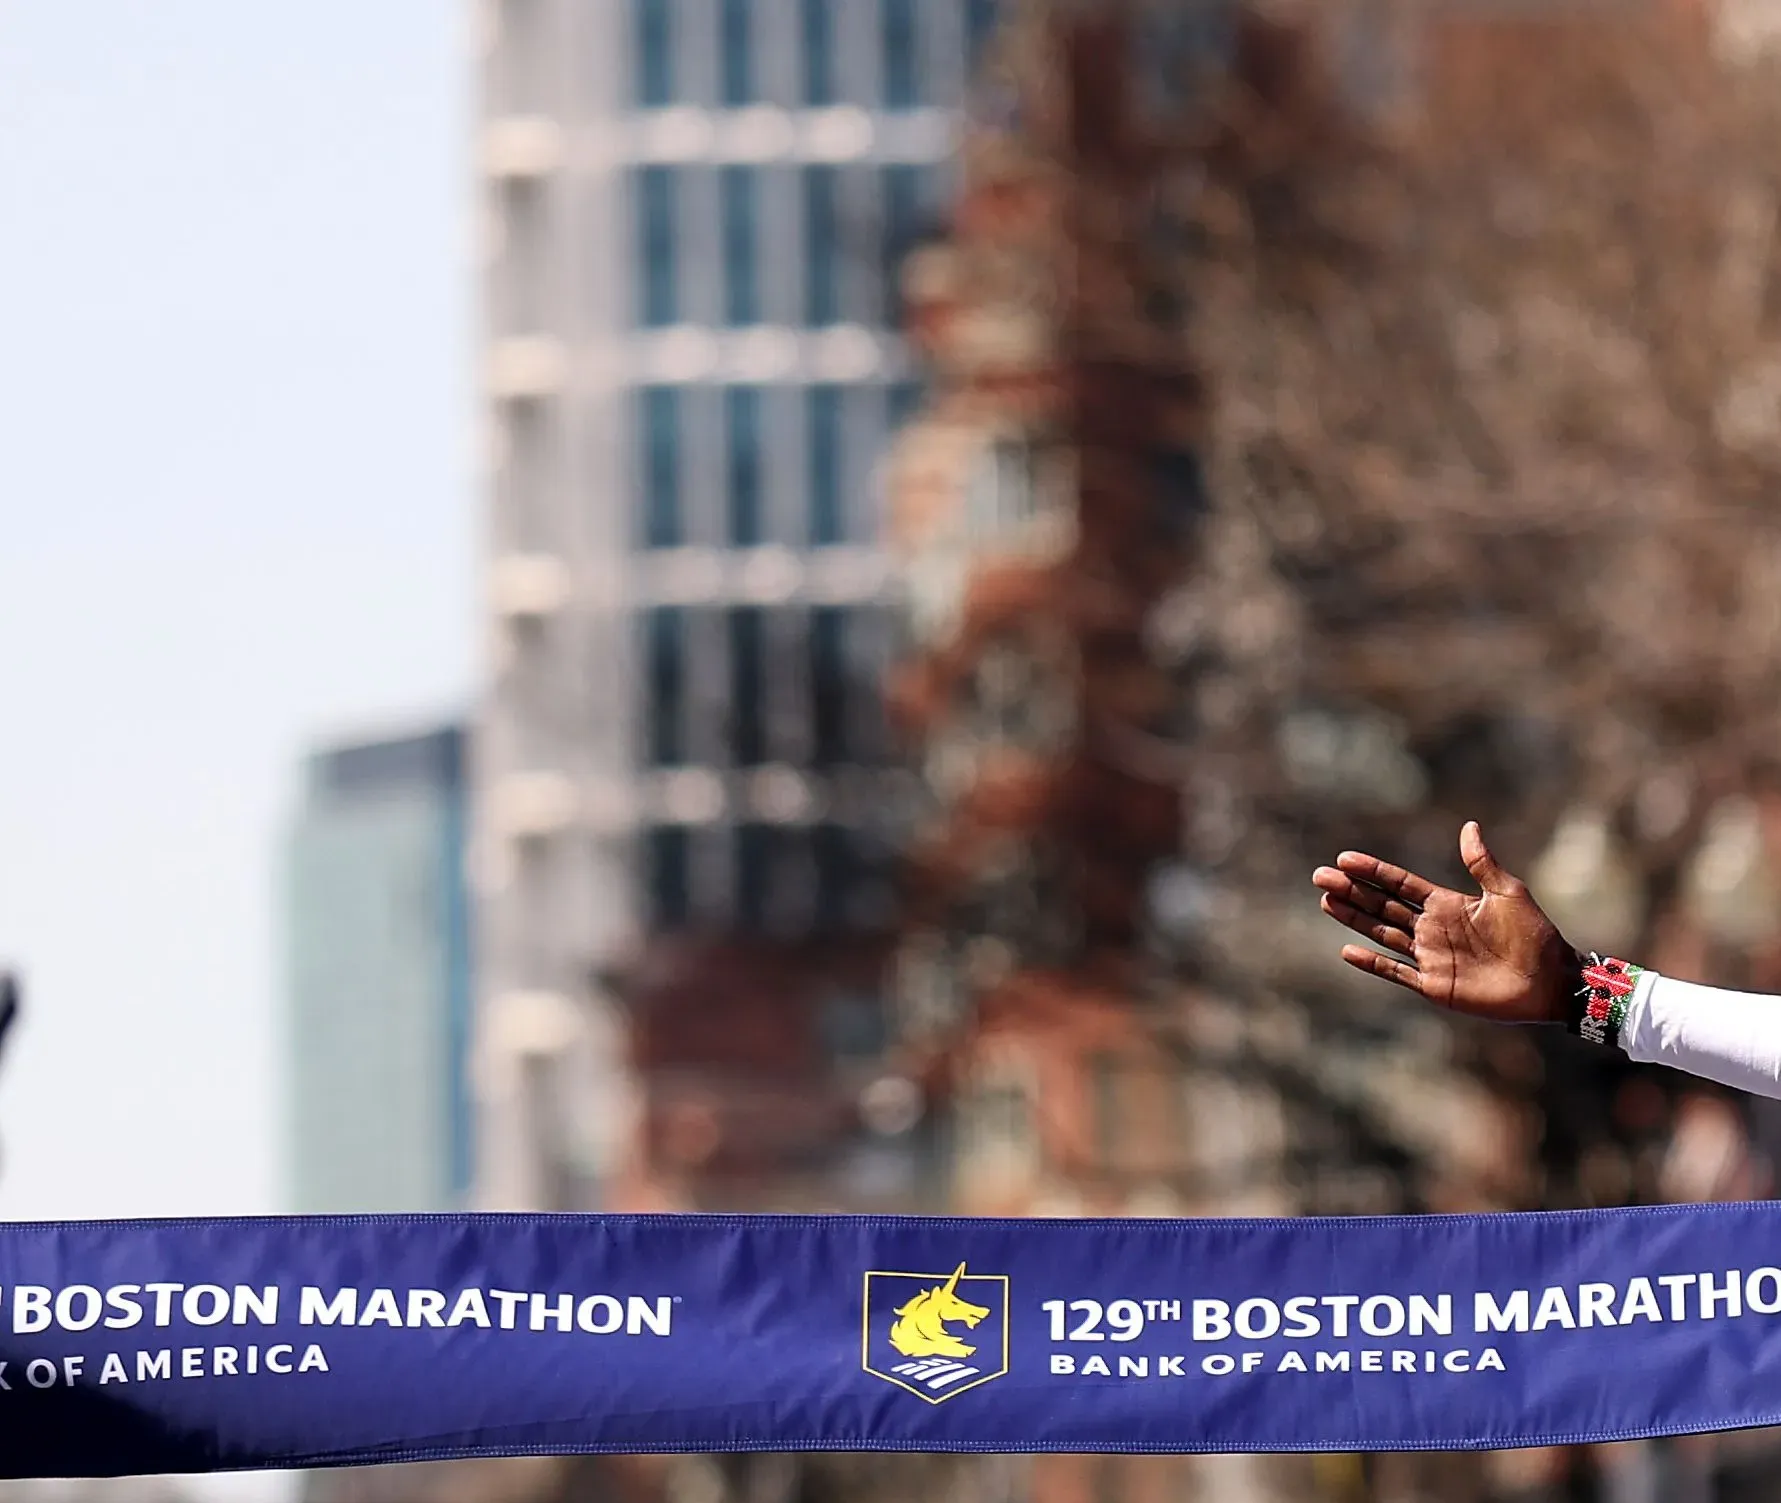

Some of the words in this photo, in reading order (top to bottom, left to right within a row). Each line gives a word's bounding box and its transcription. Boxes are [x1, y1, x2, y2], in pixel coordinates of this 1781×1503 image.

[13, 1282, 279, 1334] BOSTON
[299, 1285, 673, 1336] MARATHON
[1042, 1299, 1182, 1341] 129TH
[1192, 1294, 1453, 1341] BOSTON
[25, 1356, 86, 1389] OF
[99, 1344, 331, 1385] AMERICA
[1049, 1353, 1187, 1377] BANK
[1201, 1350, 1265, 1375] OF
[1277, 1348, 1506, 1374] AMERICA
